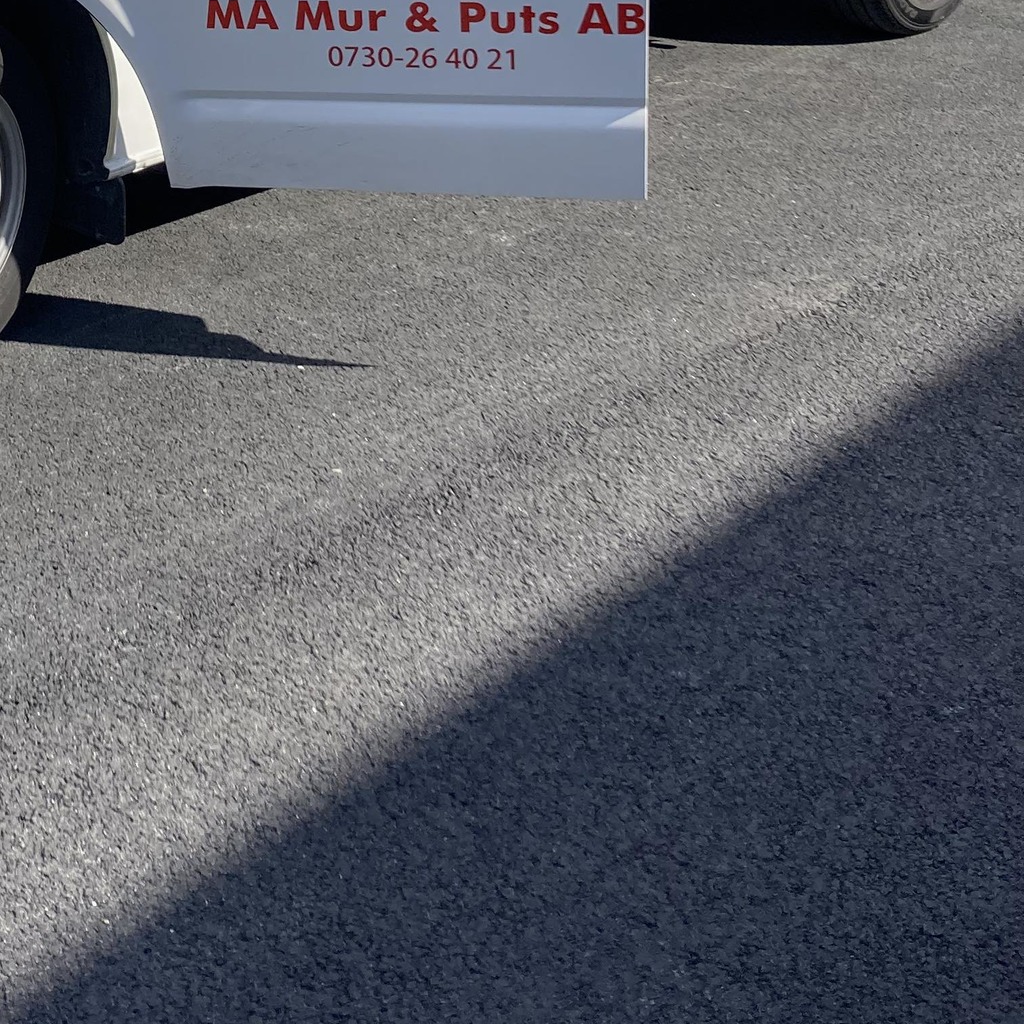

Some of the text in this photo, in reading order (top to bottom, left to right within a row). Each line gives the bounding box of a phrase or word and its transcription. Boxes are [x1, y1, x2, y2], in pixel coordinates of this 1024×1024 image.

[206, 0, 645, 35] MA Mur & Puts AB
[328, 45, 517, 71] 0730-26 40 21
